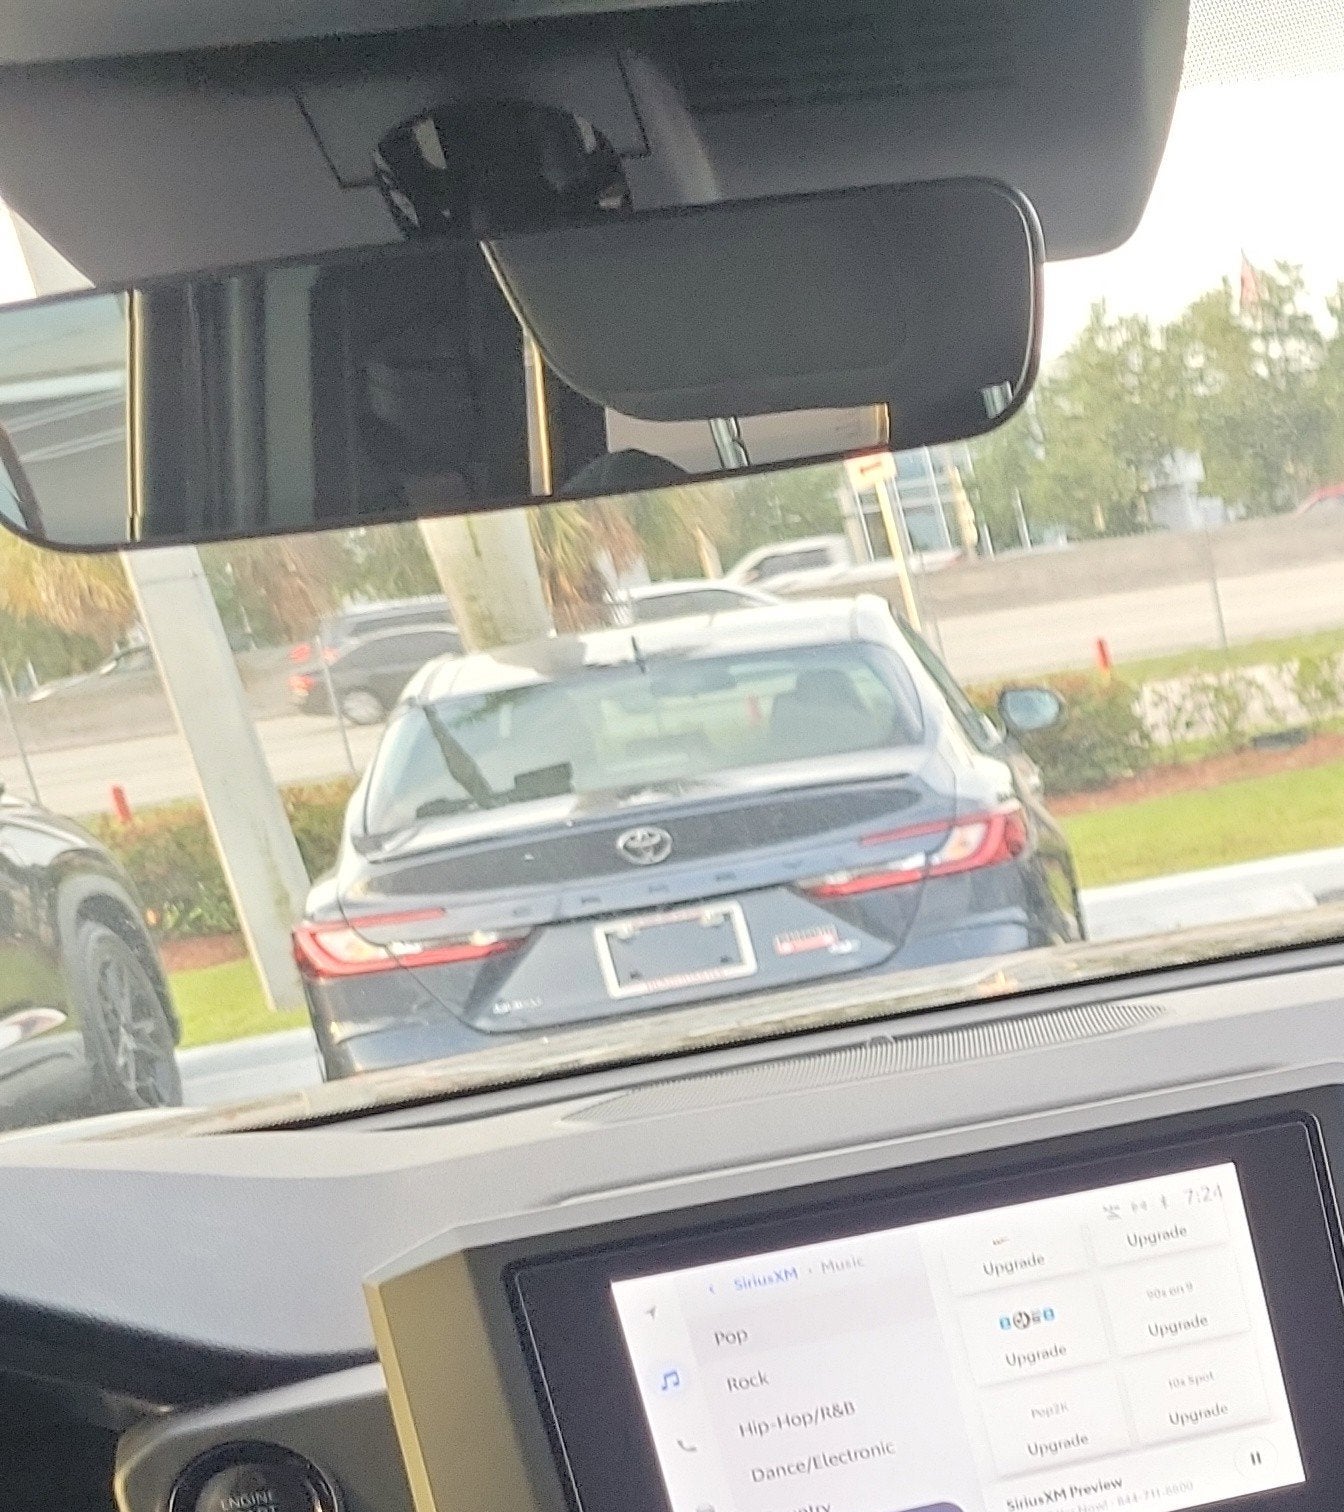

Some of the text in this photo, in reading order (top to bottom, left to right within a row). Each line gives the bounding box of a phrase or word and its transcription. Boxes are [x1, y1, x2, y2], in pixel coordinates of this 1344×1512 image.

[1183, 1183, 1223, 1205] 7:24
[1126, 1225, 1188, 1249] Upgrade
[733, 1255, 864, 1291] SiriusXM Music
[982, 1252, 1046, 1277] Upgrade
[714, 1328, 749, 1347] Pop
[1148, 1313, 1209, 1338] Upgrade
[1005, 1343, 1068, 1368] Upgrade
[727, 1370, 770, 1392] Rock
[738, 1400, 856, 1438] Hip-Hop/R&B
[1168, 1403, 1229, 1428] Upgrade
[1027, 1433, 1090, 1459] Upgrade
[750, 1440, 897, 1484] Dance/Electronic
[221, 1489, 274, 1512] ENGINE
[1006, 1477, 1124, 1512] SiriusXM Preview
